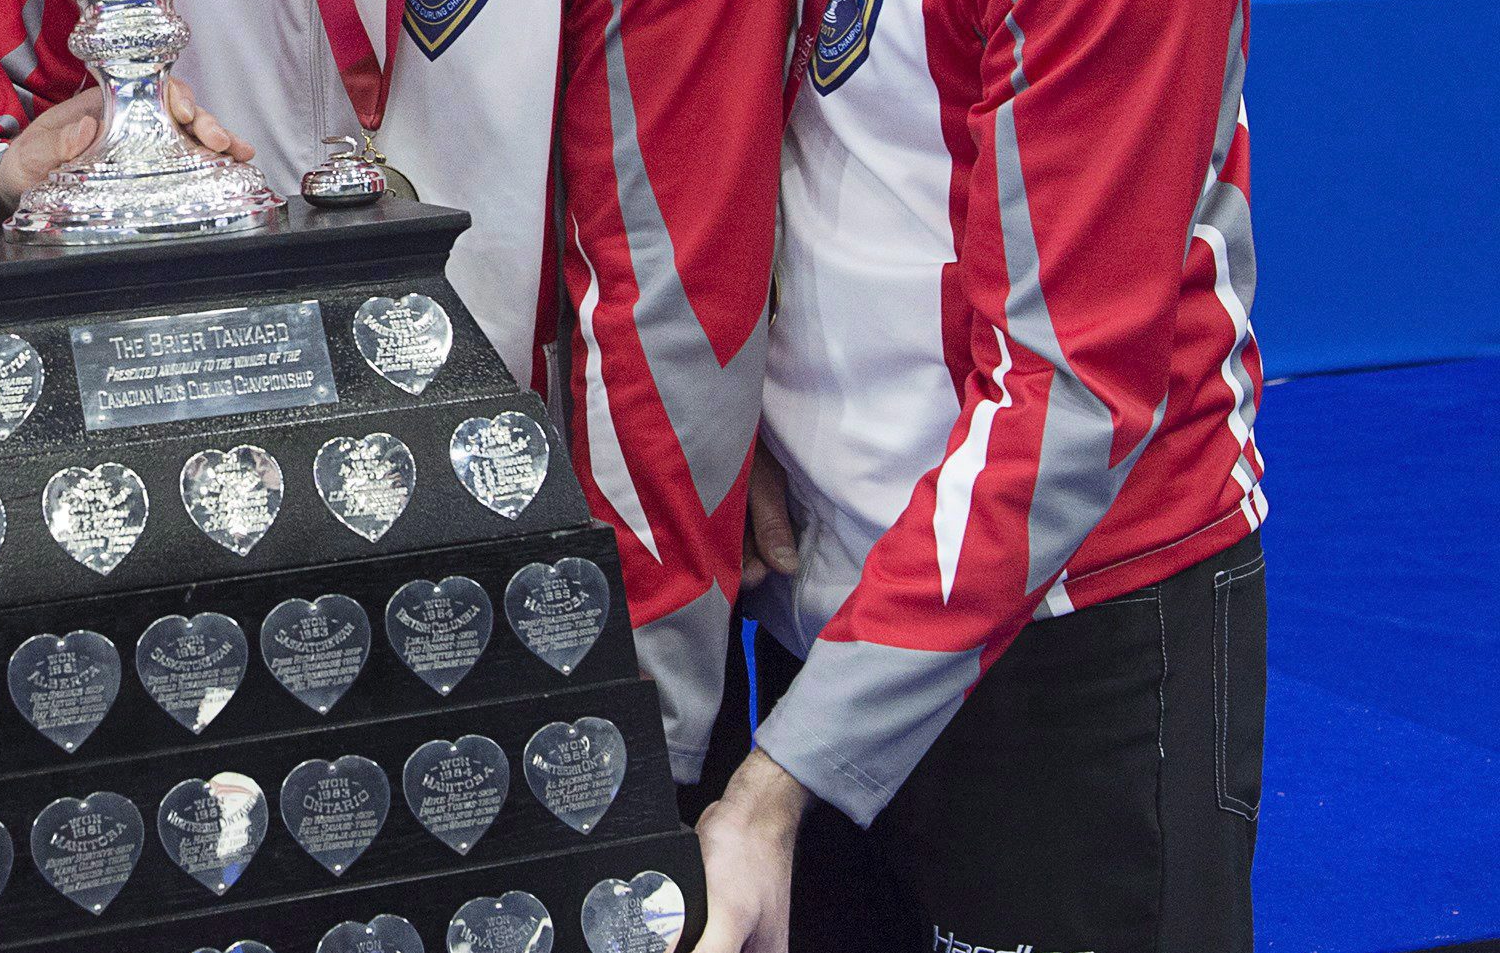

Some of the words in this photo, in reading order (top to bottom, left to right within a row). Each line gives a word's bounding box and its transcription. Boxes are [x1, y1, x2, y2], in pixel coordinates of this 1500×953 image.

[419, 4, 448, 20] CURLING
[109, 336, 146, 360] THE
[149, 331, 207, 357] BRIER
[207, 322, 290, 349] TANKARD
[106, 365, 157, 383] PRESENTED
[215, 357, 233, 371] THE
[268, 351, 281, 365] OF
[282, 348, 302, 363] THE
[98, 386, 155, 411] CANADIAN
[186, 379, 233, 400] CURLING
[234, 369, 315, 396] CHAMPIONSHIP
[318, 778, 349, 790] WON
[422, 766, 495, 793] MANITOBA
[303, 789, 370, 814] ONTARIO
[318, 788, 351, 801] 1983
[68, 813, 102, 827] WON
[50, 822, 128, 852] MANITOBA
